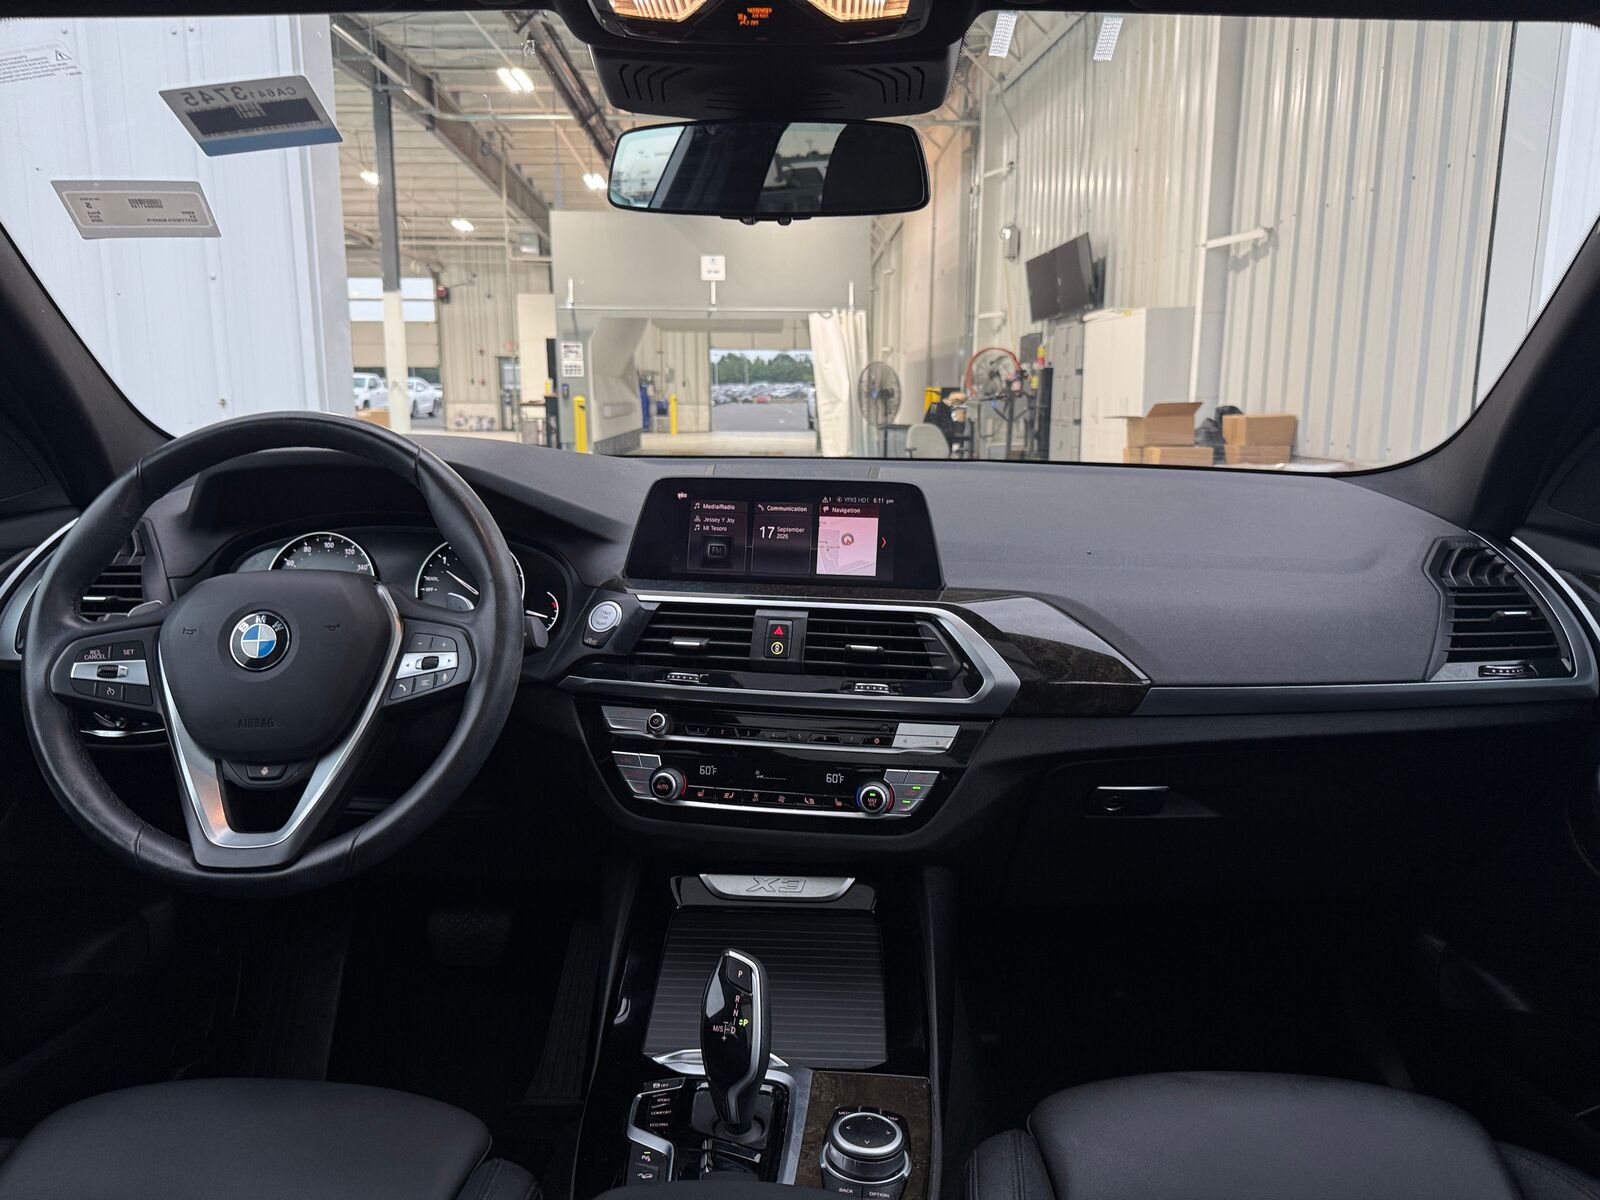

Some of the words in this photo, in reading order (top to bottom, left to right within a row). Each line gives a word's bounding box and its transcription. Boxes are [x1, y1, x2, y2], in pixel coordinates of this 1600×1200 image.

[831, 506, 861, 514] Navigation
[759, 526, 776, 539] 17
[442, 556, 447, 564] 1
[238, 615, 284, 633] BMW
[238, 718, 274, 729] AIRBAG
[745, 876, 807, 894] X3
[737, 970, 744, 978] P
[734, 995, 741, 1003] R
[732, 1009, 739, 1017] N
[712, 1024, 724, 1033] M/S
[730, 1026, 737, 1035] D
[838, 1187, 854, 1195] BACK
